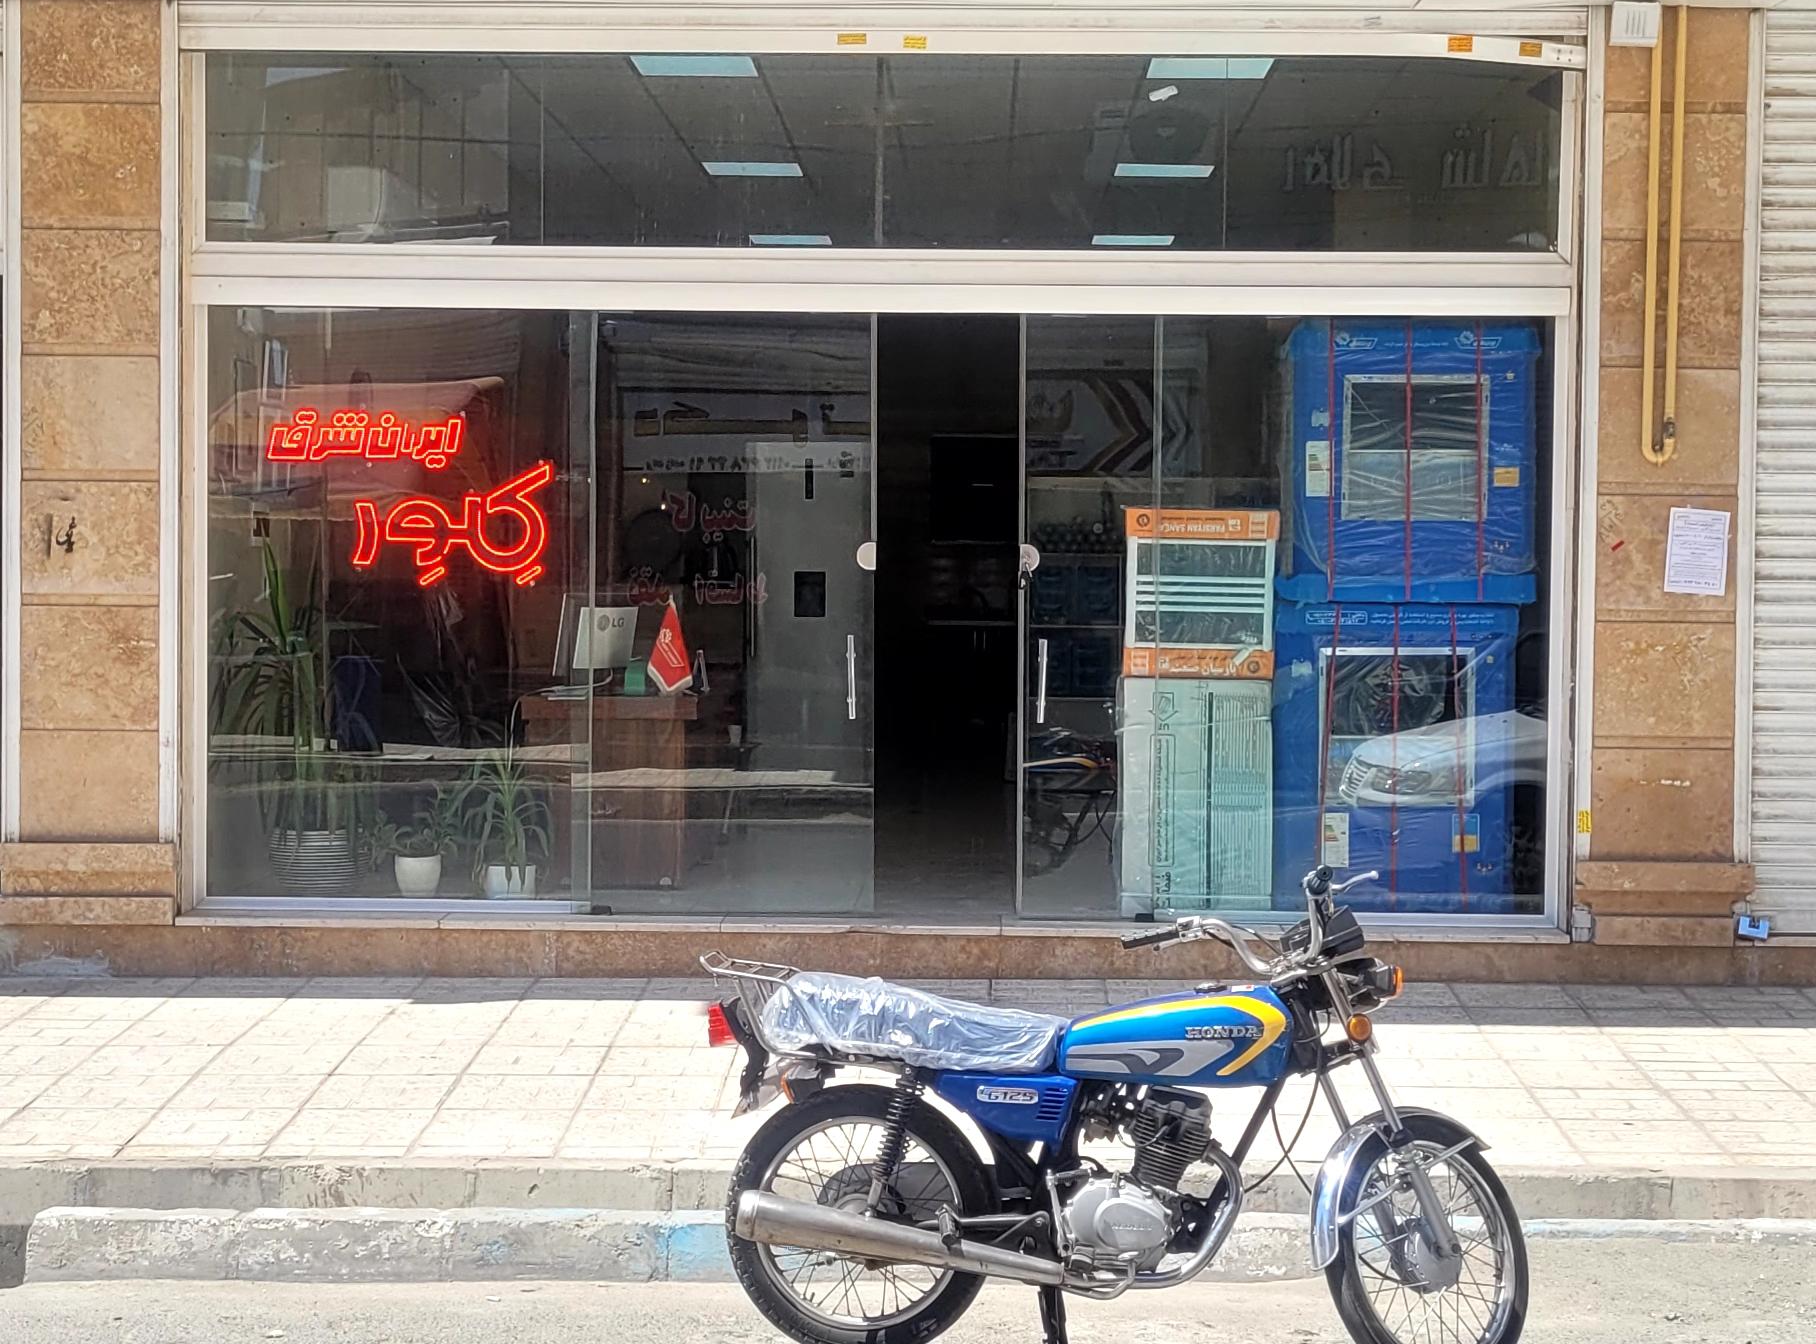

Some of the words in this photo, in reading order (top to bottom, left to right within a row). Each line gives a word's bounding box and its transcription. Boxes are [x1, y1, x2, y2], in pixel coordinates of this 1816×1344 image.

[267, 410, 369, 461] شرق
[365, 412, 463, 469] ایران
[611, 617, 625, 628] LG
[1184, 1024, 1264, 1040] HONDA
